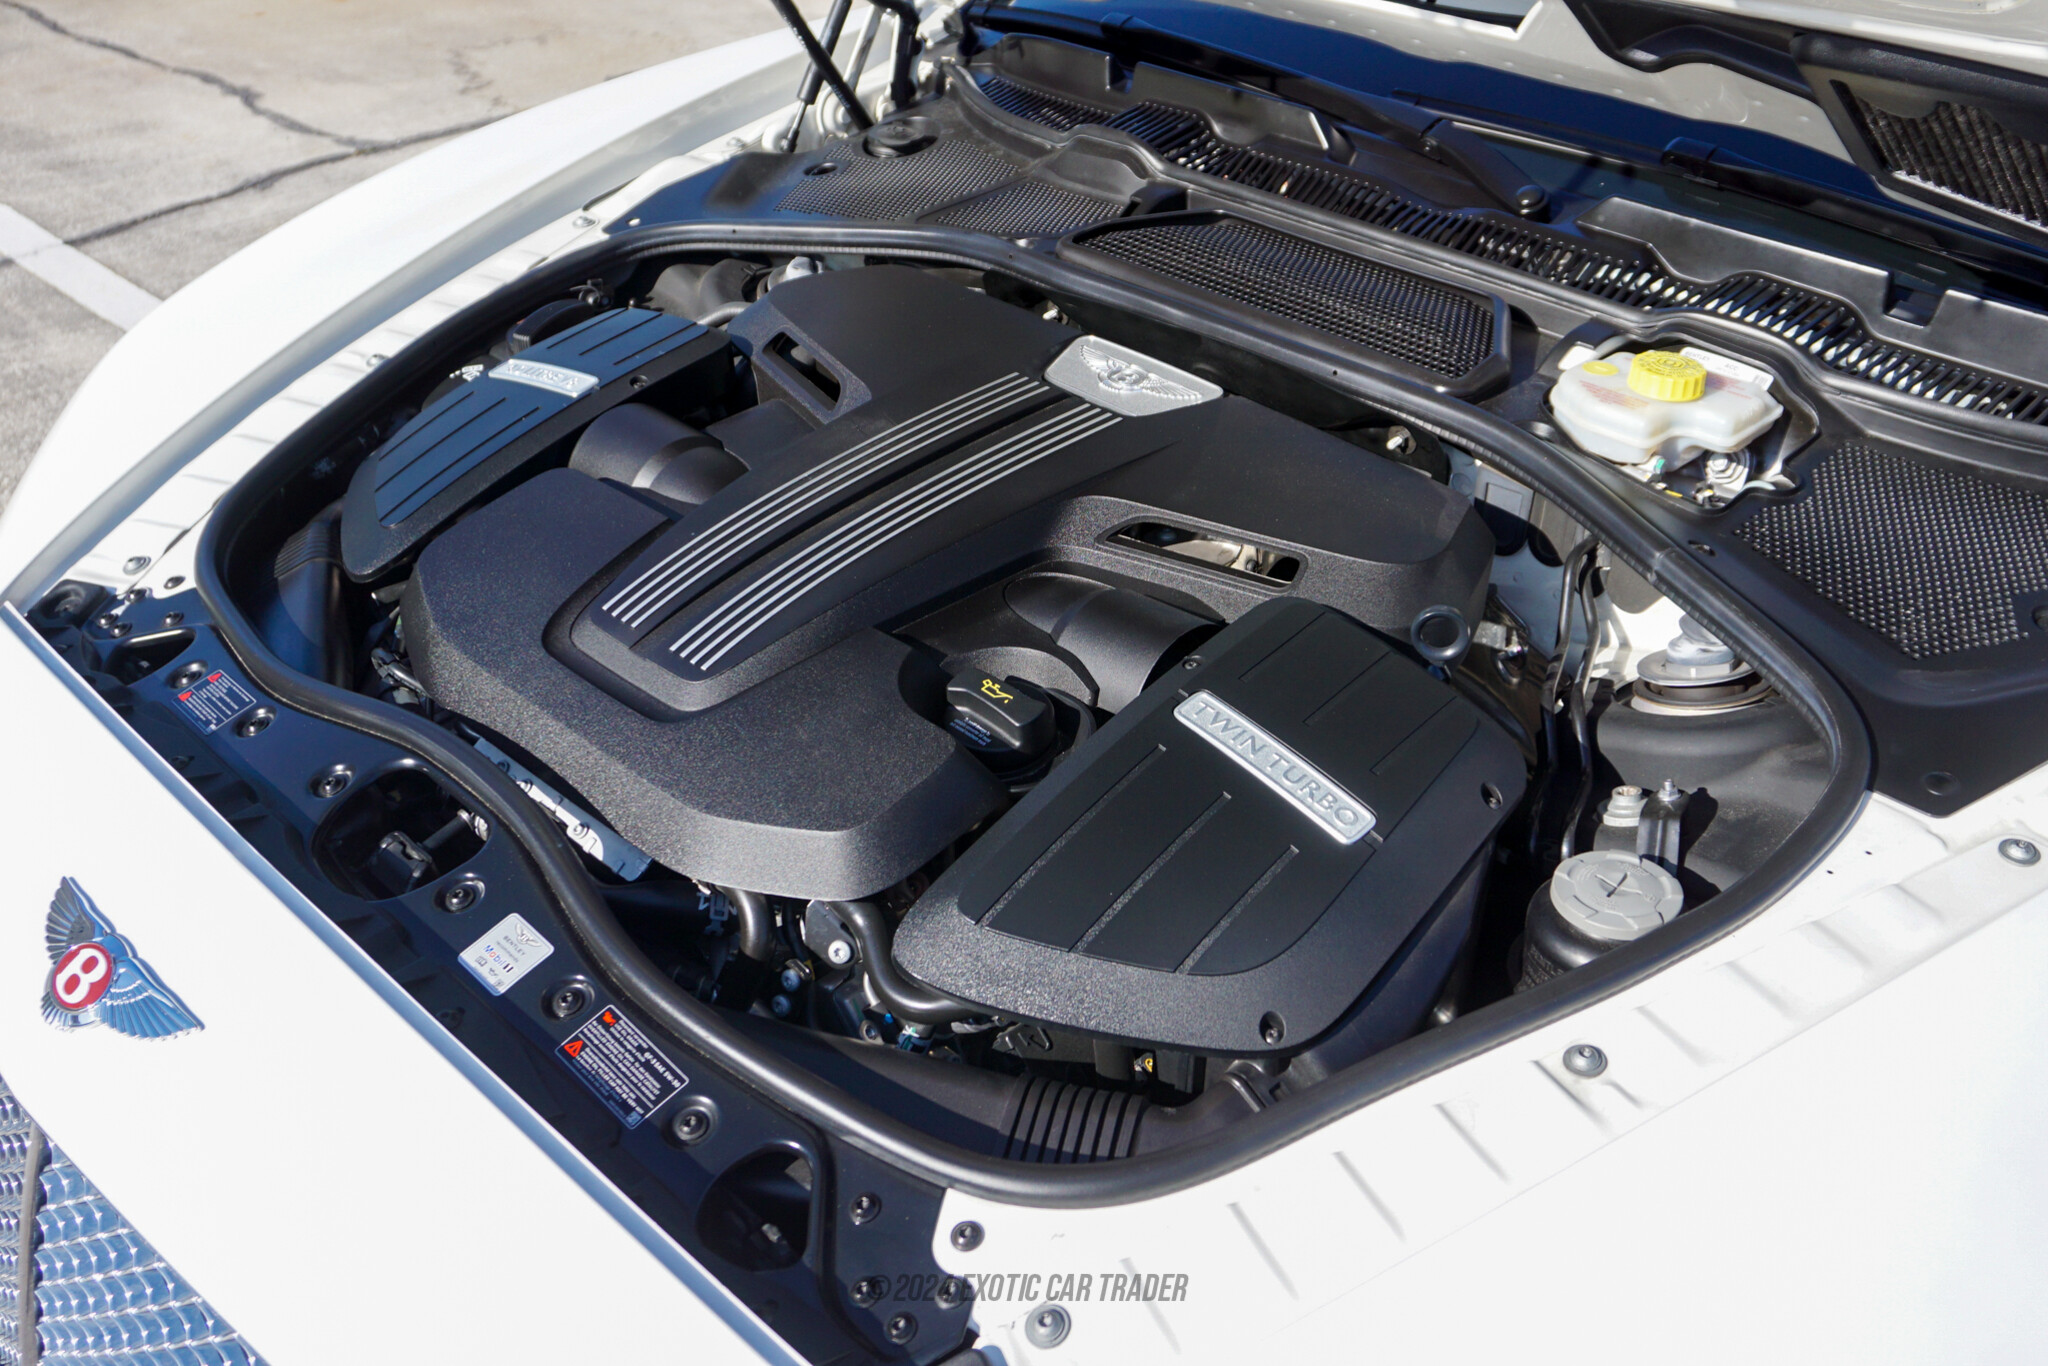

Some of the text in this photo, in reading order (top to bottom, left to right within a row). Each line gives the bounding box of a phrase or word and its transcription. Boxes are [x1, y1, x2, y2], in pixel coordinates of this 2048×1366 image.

[1192, 701, 1359, 827] TWIN TURBO
[483, 944, 506, 966] Mobil
[503, 935, 525, 956] BENTLEY
[653, 1061, 666, 1073] SAE
